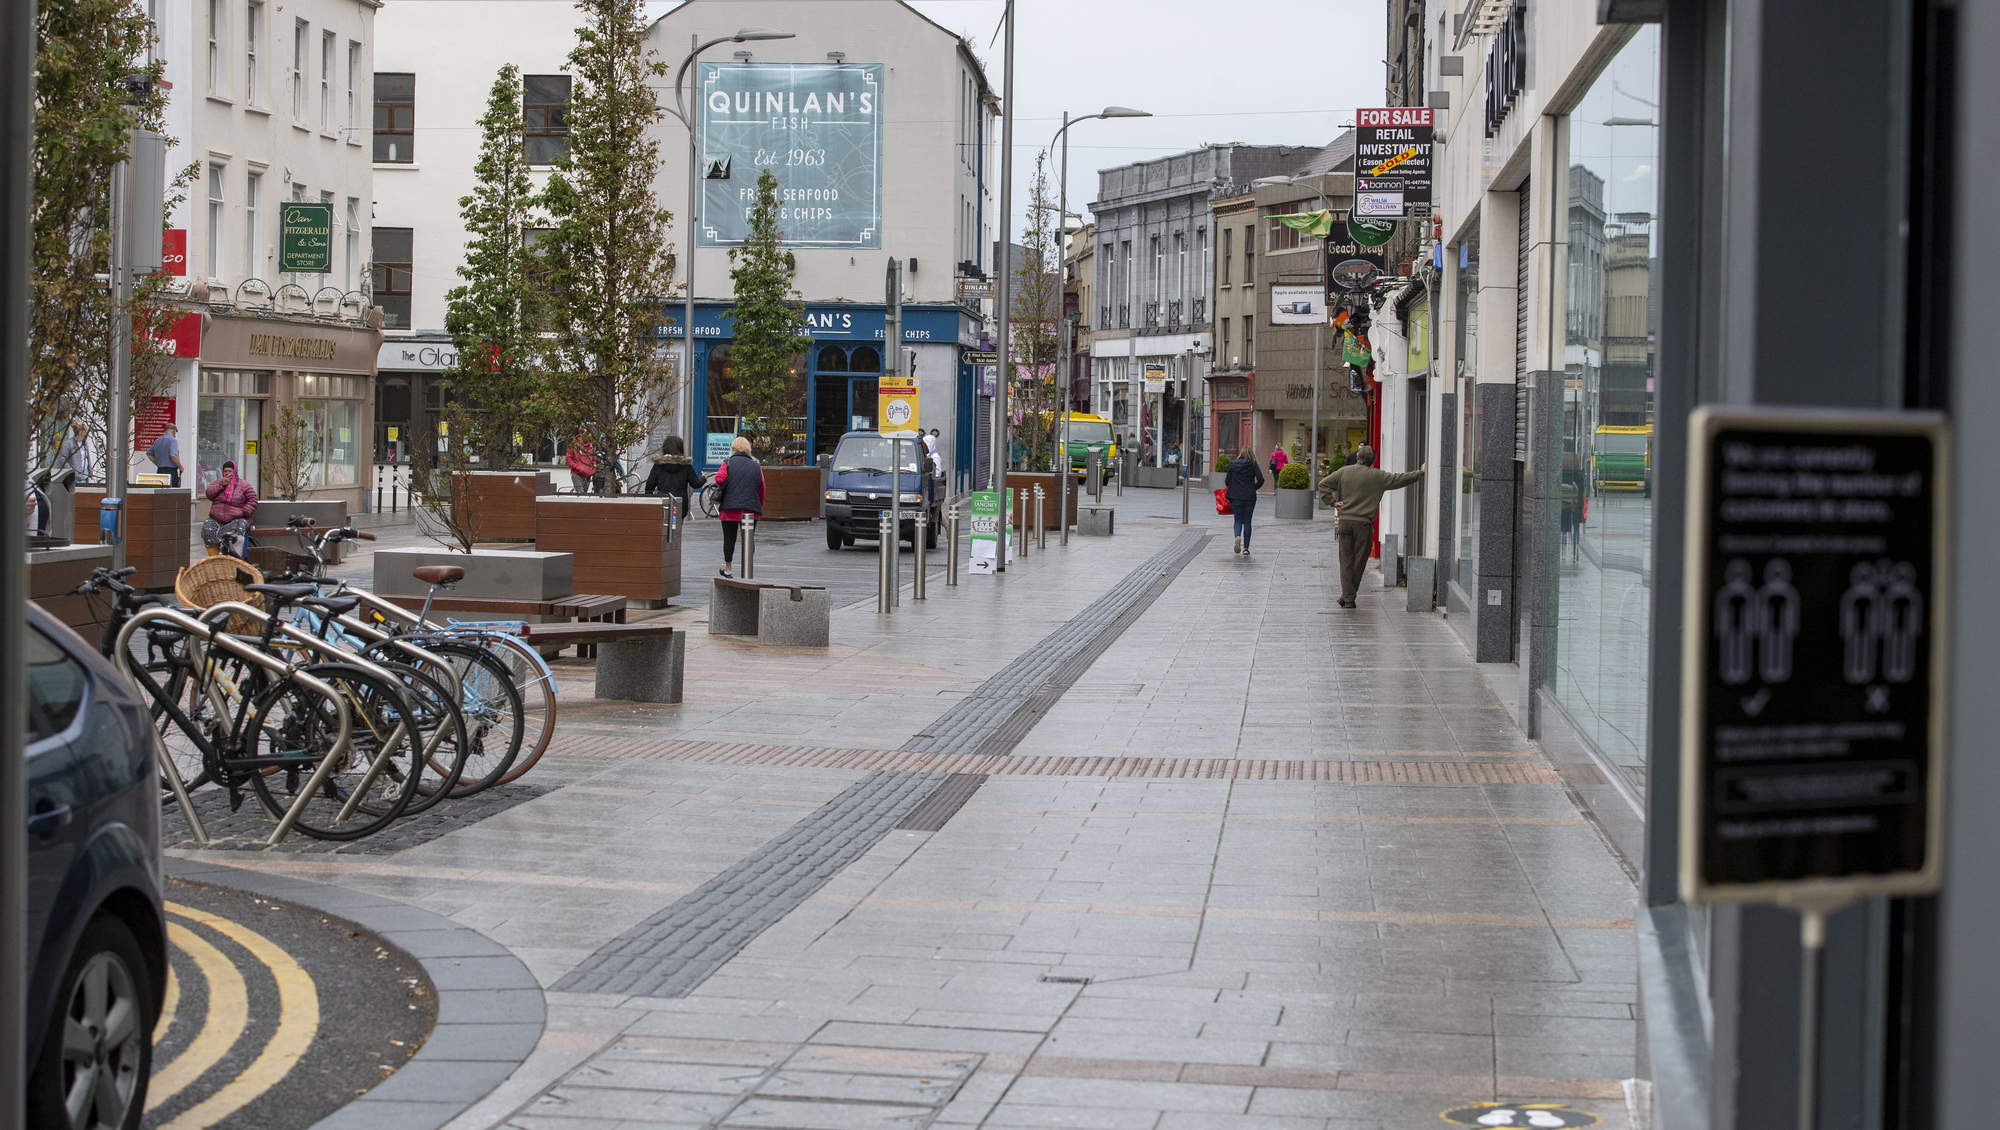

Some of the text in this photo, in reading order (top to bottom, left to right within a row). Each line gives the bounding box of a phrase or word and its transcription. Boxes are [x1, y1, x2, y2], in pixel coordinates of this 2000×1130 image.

[708, 90, 873, 114] QUINLAN'S
[772, 116, 808, 130] FISH
[1360, 110, 1430, 125] FOR SALE
[1375, 128, 1415, 140] RETAIL
[754, 148, 826, 166] Est. 1963
[1362, 158, 1383, 166] Eason
[1377, 152, 1410, 173] SOLD
[1369, 181, 1402, 189] bannon
[740, 188, 839, 201] FRH SEAFOOD
[286, 210, 313, 224] Dan
[780, 207, 788, 219] &
[793, 207, 832, 220] CHIPS
[285, 226, 330, 235] FITZGERALD
[297, 237, 328, 247] & Sons
[1328, 241, 1357, 256] Teach
[286, 252, 325, 260] DEPARTMENT
[296, 259, 315, 267] STORE
[692, 326, 721, 335] EAFOOD
[905, 330, 931, 339] CHIPS
[250, 333, 271, 355] DAN
[402, 350, 415, 361] The
